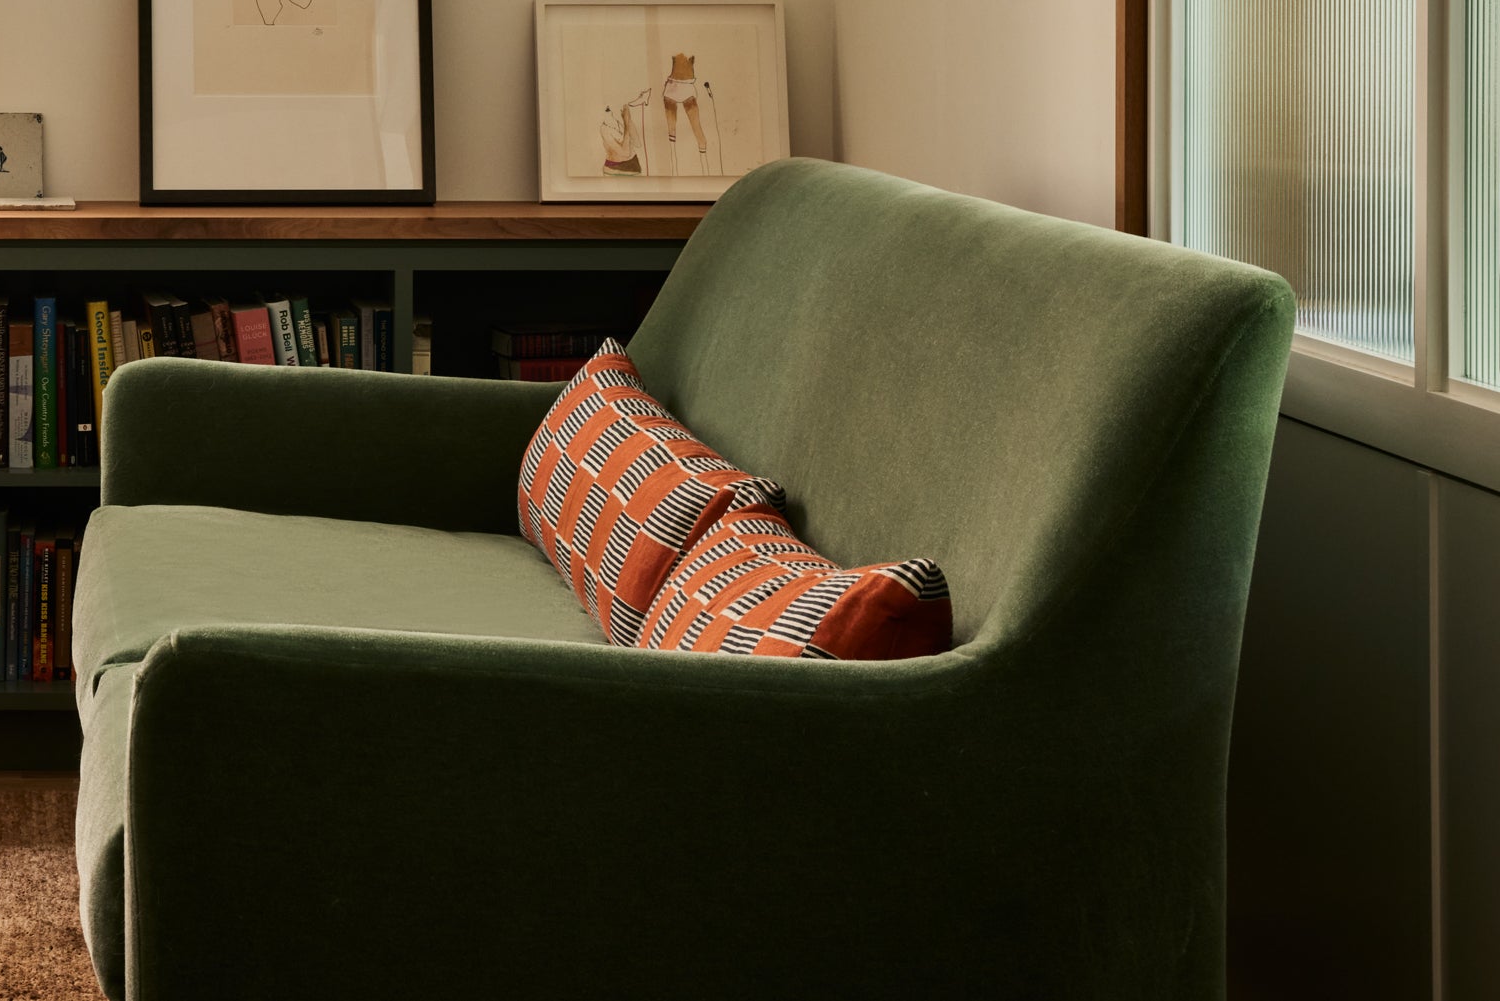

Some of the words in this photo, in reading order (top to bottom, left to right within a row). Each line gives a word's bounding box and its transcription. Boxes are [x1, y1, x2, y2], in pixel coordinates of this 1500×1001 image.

[40, 305, 52, 326] Gary
[279, 309, 289, 331] Rob
[94, 310, 107, 344] Good
[240, 323, 268, 333] LOUISE
[297, 320, 309, 350] MEMOIRS
[39, 327, 51, 374] Shteyngart
[282, 332, 293, 352] Bell
[97, 346, 111, 386] Inside
[40, 376, 50, 391] Our
[39, 392, 51, 421] Country
[40, 422, 51, 448] Friends
[8, 551, 19, 564] THE
[8, 564, 19, 576] TAO
[7, 584, 19, 600] TIME
[40, 583, 48, 601] KISS
[39, 602, 48, 623] KISS,
[39, 622, 48, 643] BANG
[39, 644, 48, 664] BANG
